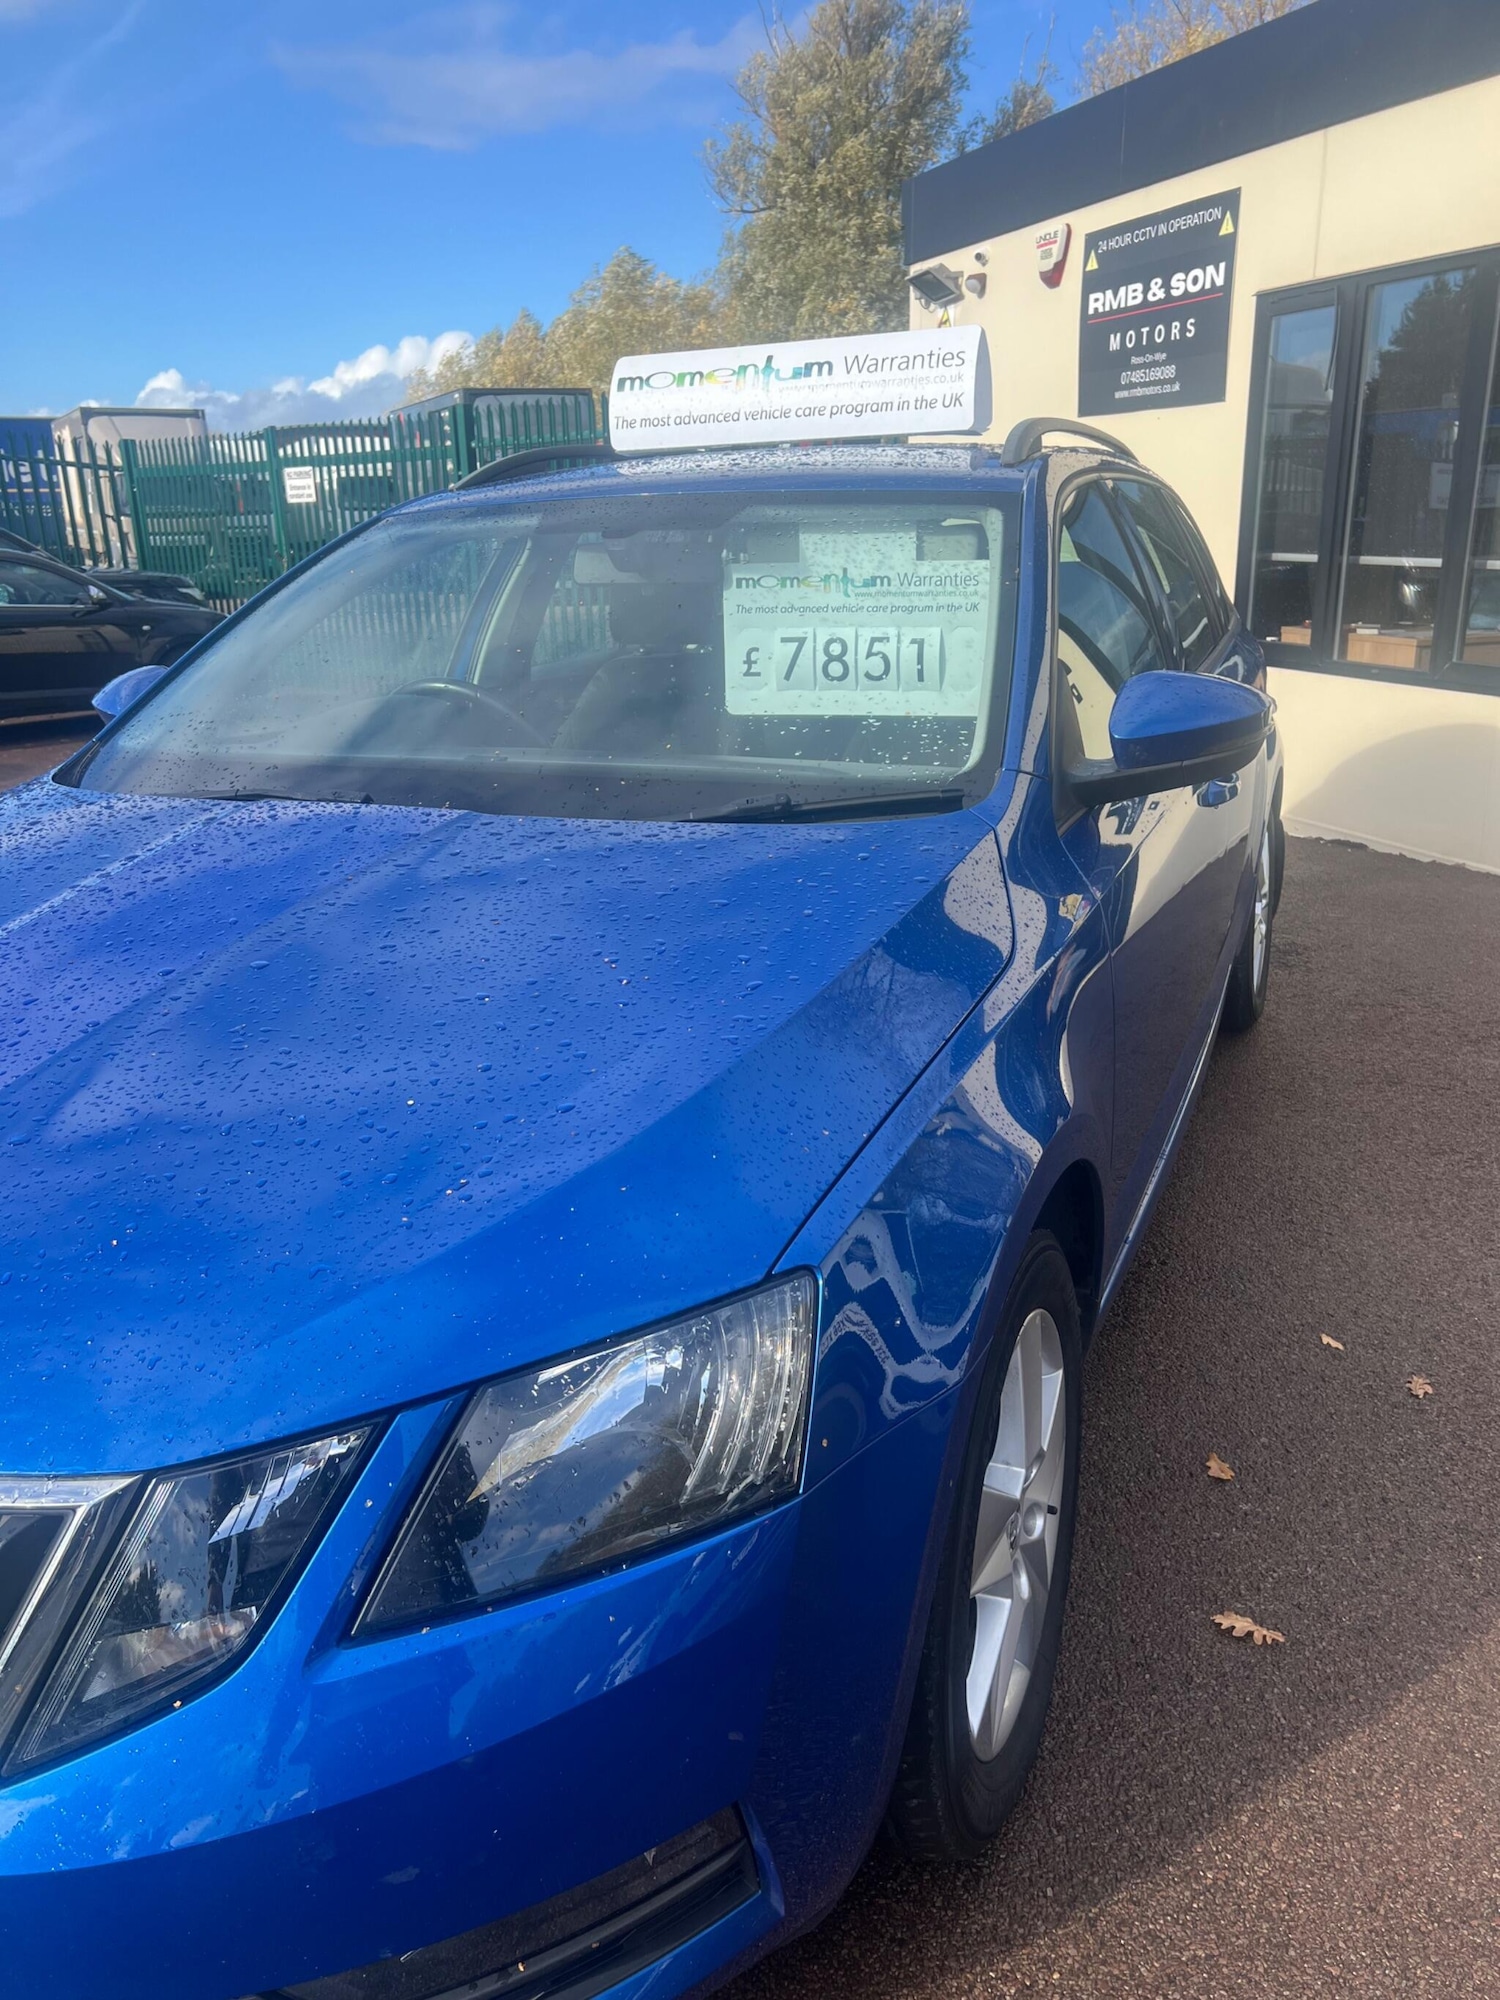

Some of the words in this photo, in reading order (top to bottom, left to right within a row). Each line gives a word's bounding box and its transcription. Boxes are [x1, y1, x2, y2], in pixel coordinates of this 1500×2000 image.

[1098, 240, 1108, 253] 24
[1108, 232, 1132, 250] HOUR
[1133, 225, 1157, 243] CCTV
[1158, 222, 1168, 236] IN
[1168, 206, 1222, 233] OPERATION
[1088, 282, 1144, 315] RMB
[1147, 277, 1166, 302] &
[1170, 261, 1226, 297] SON
[1109, 318, 1196, 352] MOTORS
[617, 355, 834, 394] momentum
[844, 347, 966, 375] Warranties
[1121, 364, 1176, 385] 07485169088
[615, 416, 637, 430] The
[640, 414, 671, 428] most
[674, 410, 740, 426] advanced
[744, 405, 791, 421] vehicle
[795, 404, 826, 418] care
[830, 399, 893, 419] program
[897, 397, 910, 412] in
[914, 395, 938, 409] the
[942, 392, 965, 408] UK
[736, 567, 891, 598] momentum
[897, 572, 979, 587] Warranties
[736, 604, 753, 614] The
[755, 605, 778, 614] most
[780, 604, 829, 614] advanced
[831, 603, 864, 613] vehicle
[866, 604, 888, 613] care
[890, 604, 933, 615] program
[936, 602, 944, 612] in
[946, 602, 963, 612] the
[965, 602, 980, 612] UK
